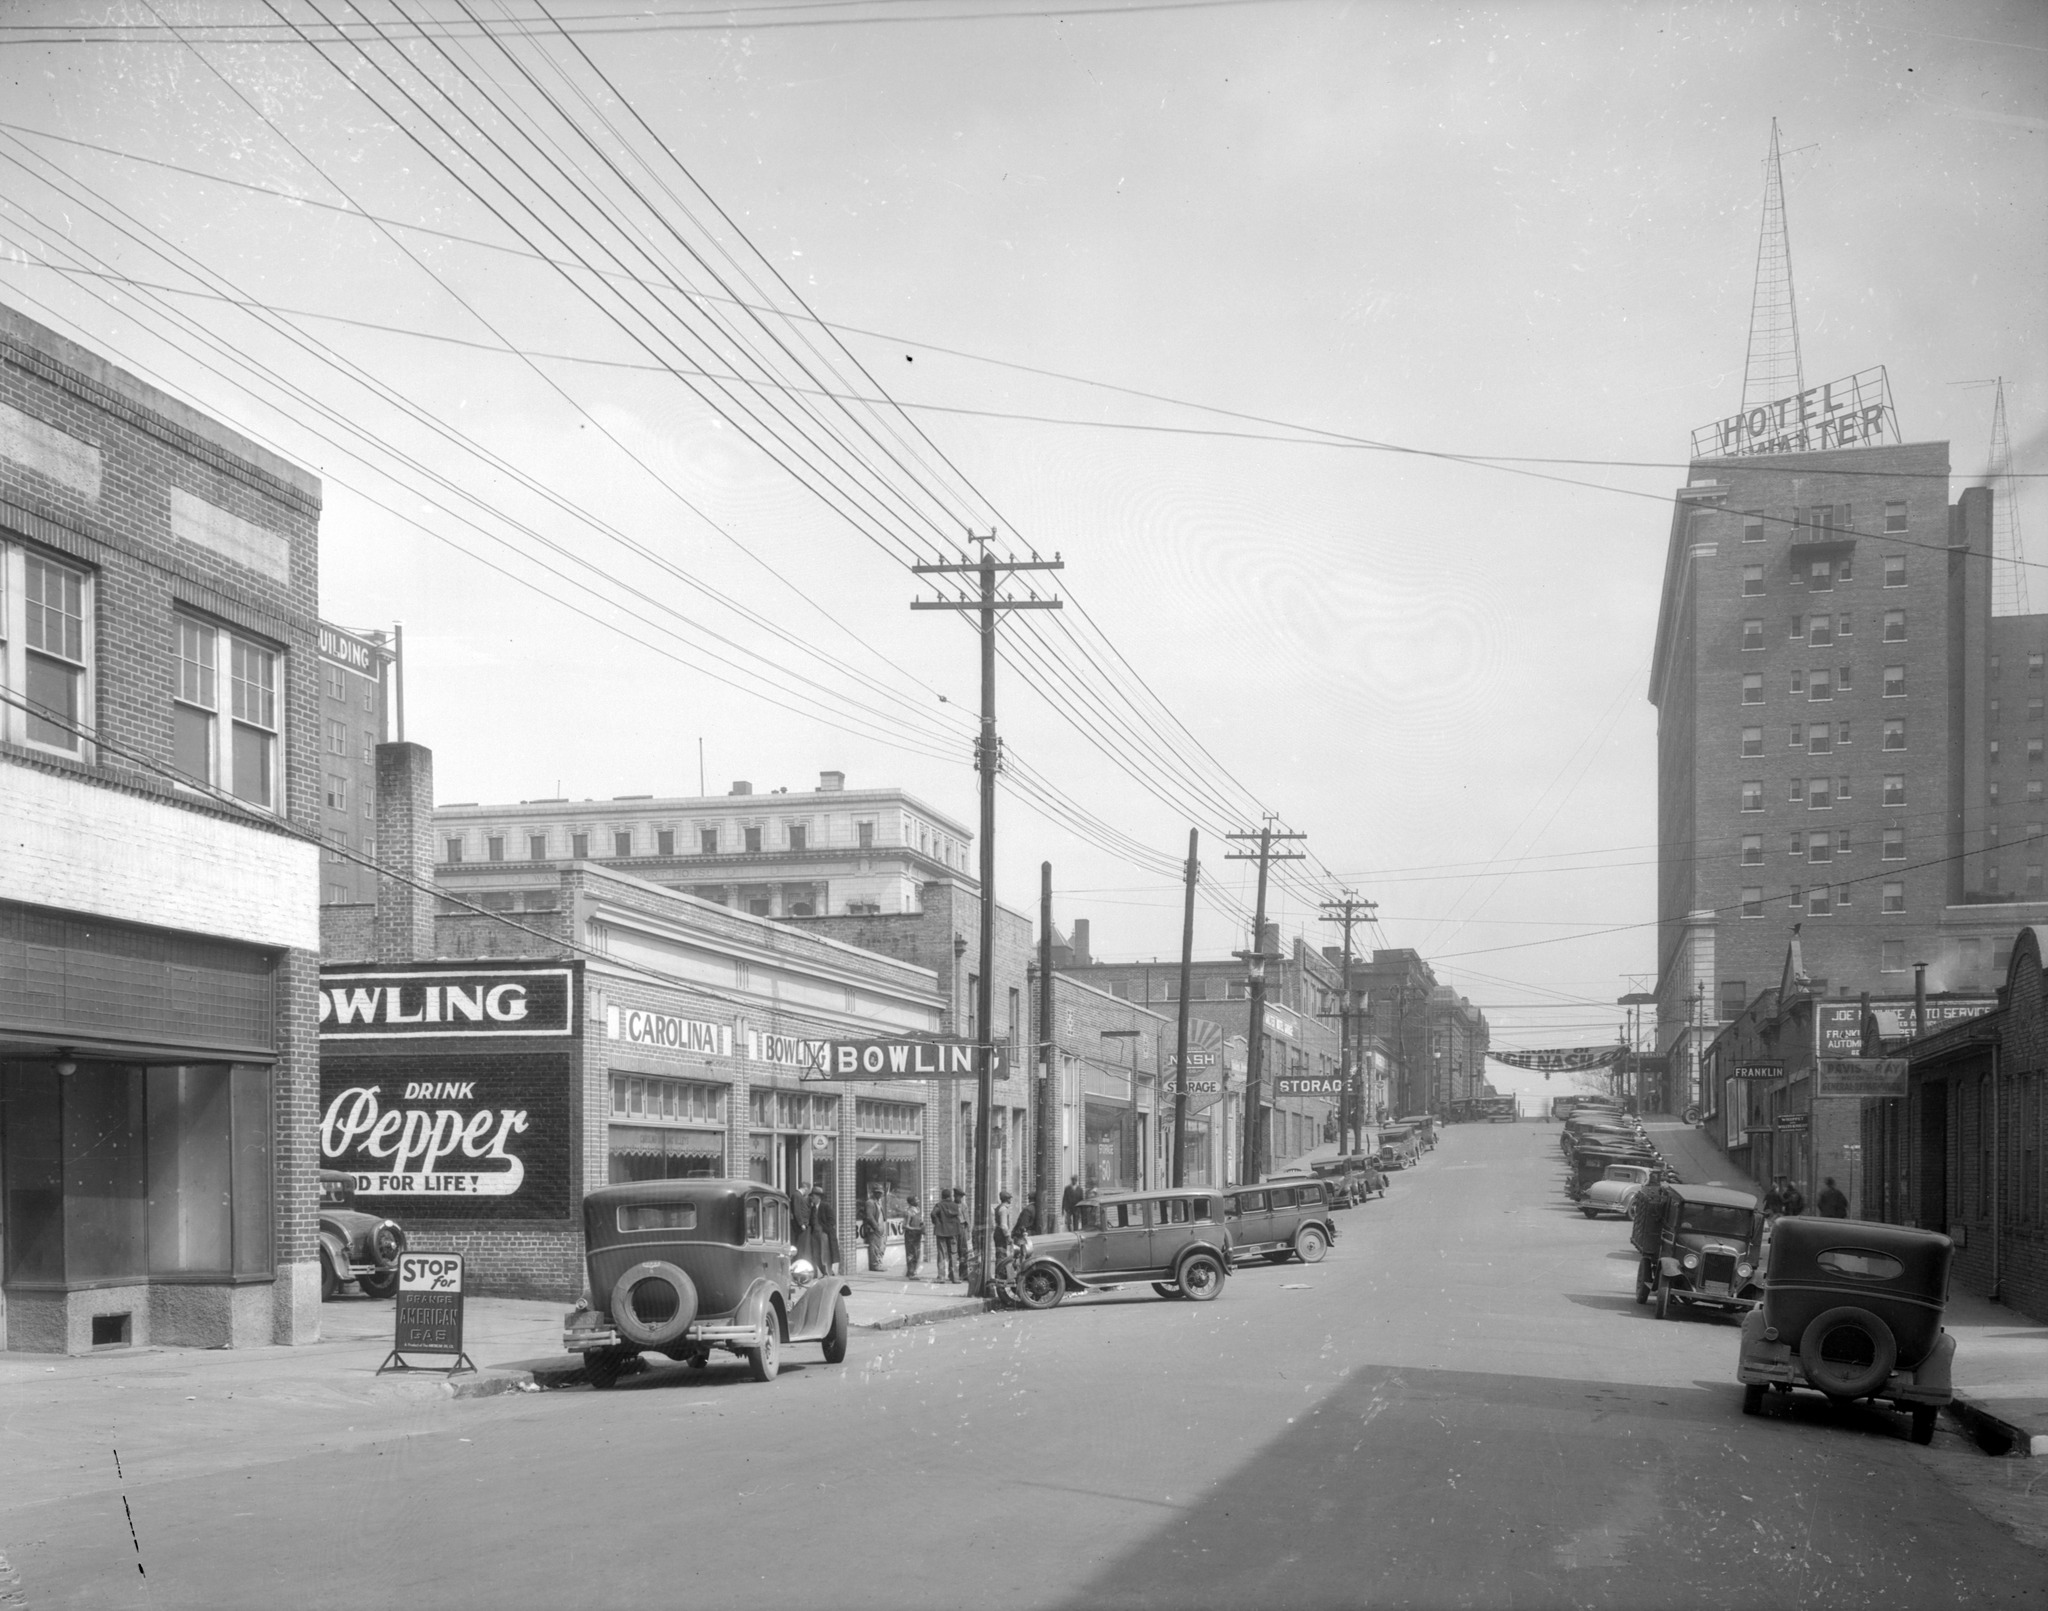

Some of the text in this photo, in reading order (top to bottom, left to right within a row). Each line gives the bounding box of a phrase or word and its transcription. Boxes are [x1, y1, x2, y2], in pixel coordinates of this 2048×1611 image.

[1724, 384, 1843, 446] HOTEL
[319, 628, 369, 669] UILDING
[319, 984, 529, 1024] WLING
[1832, 1010, 1854, 1021] JOE
[1909, 1008, 1940, 1019] ATO
[628, 1011, 714, 1052] CAROLINA
[766, 1035, 826, 1068] BOWLING
[837, 1045, 999, 1073] BOWLIN
[1735, 1067, 1783, 1077] FRANKLIN
[404, 1082, 477, 1100] DRINK
[1167, 1081, 1216, 1093] SRAGE
[320, 1085, 529, 1174] Pepper
[379, 1176, 414, 1191] FOR
[403, 1259, 458, 1282] STOP
[430, 1275, 456, 1290] for
[401, 1307, 458, 1326] AMERICAN
[410, 1329, 447, 1341] GAS
